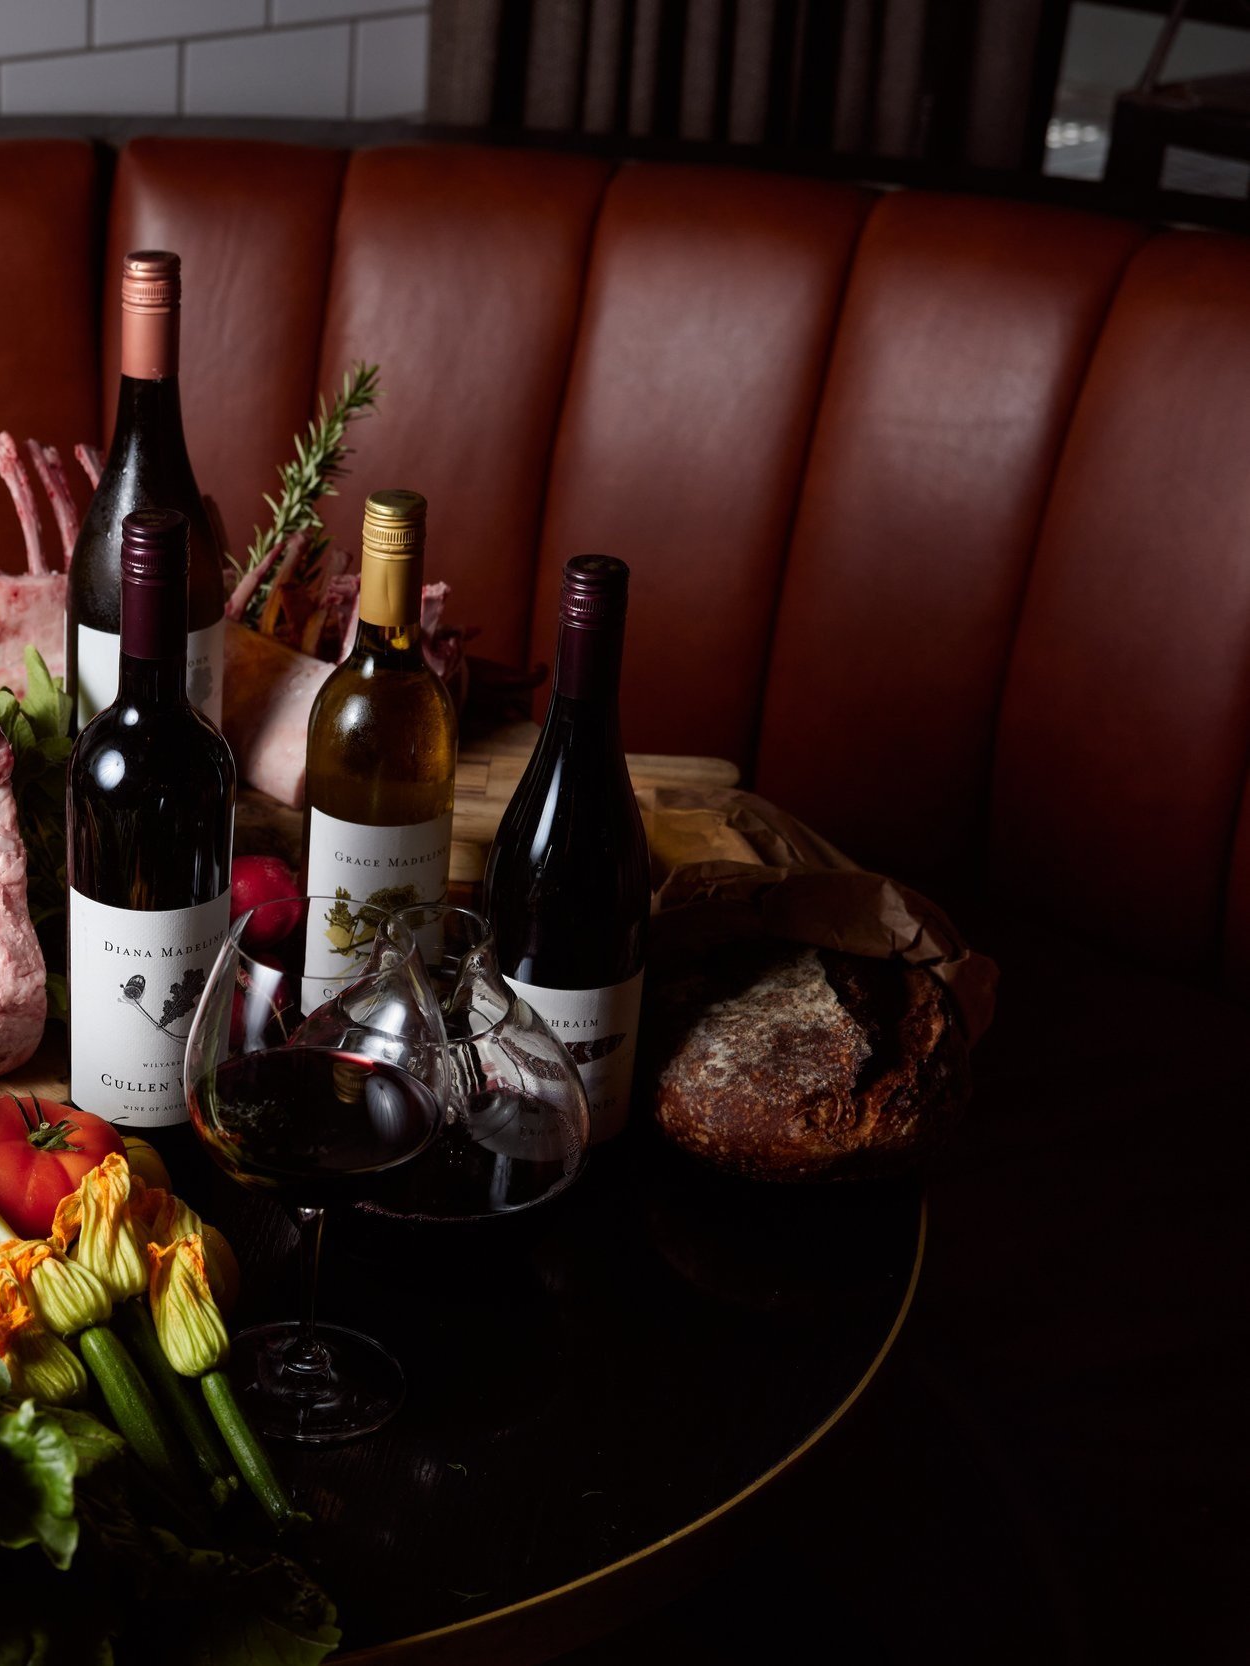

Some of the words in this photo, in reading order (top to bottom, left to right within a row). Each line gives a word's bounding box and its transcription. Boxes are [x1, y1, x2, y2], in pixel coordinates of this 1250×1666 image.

[334, 851, 381, 868] GRACE
[104, 940, 153, 958] DIANA
[161, 929, 225, 958] MADELINE
[544, 1018, 598, 1028] HRAIM
[100, 1073, 170, 1092] CULLEN
[123, 1104, 145, 1112] WINE
